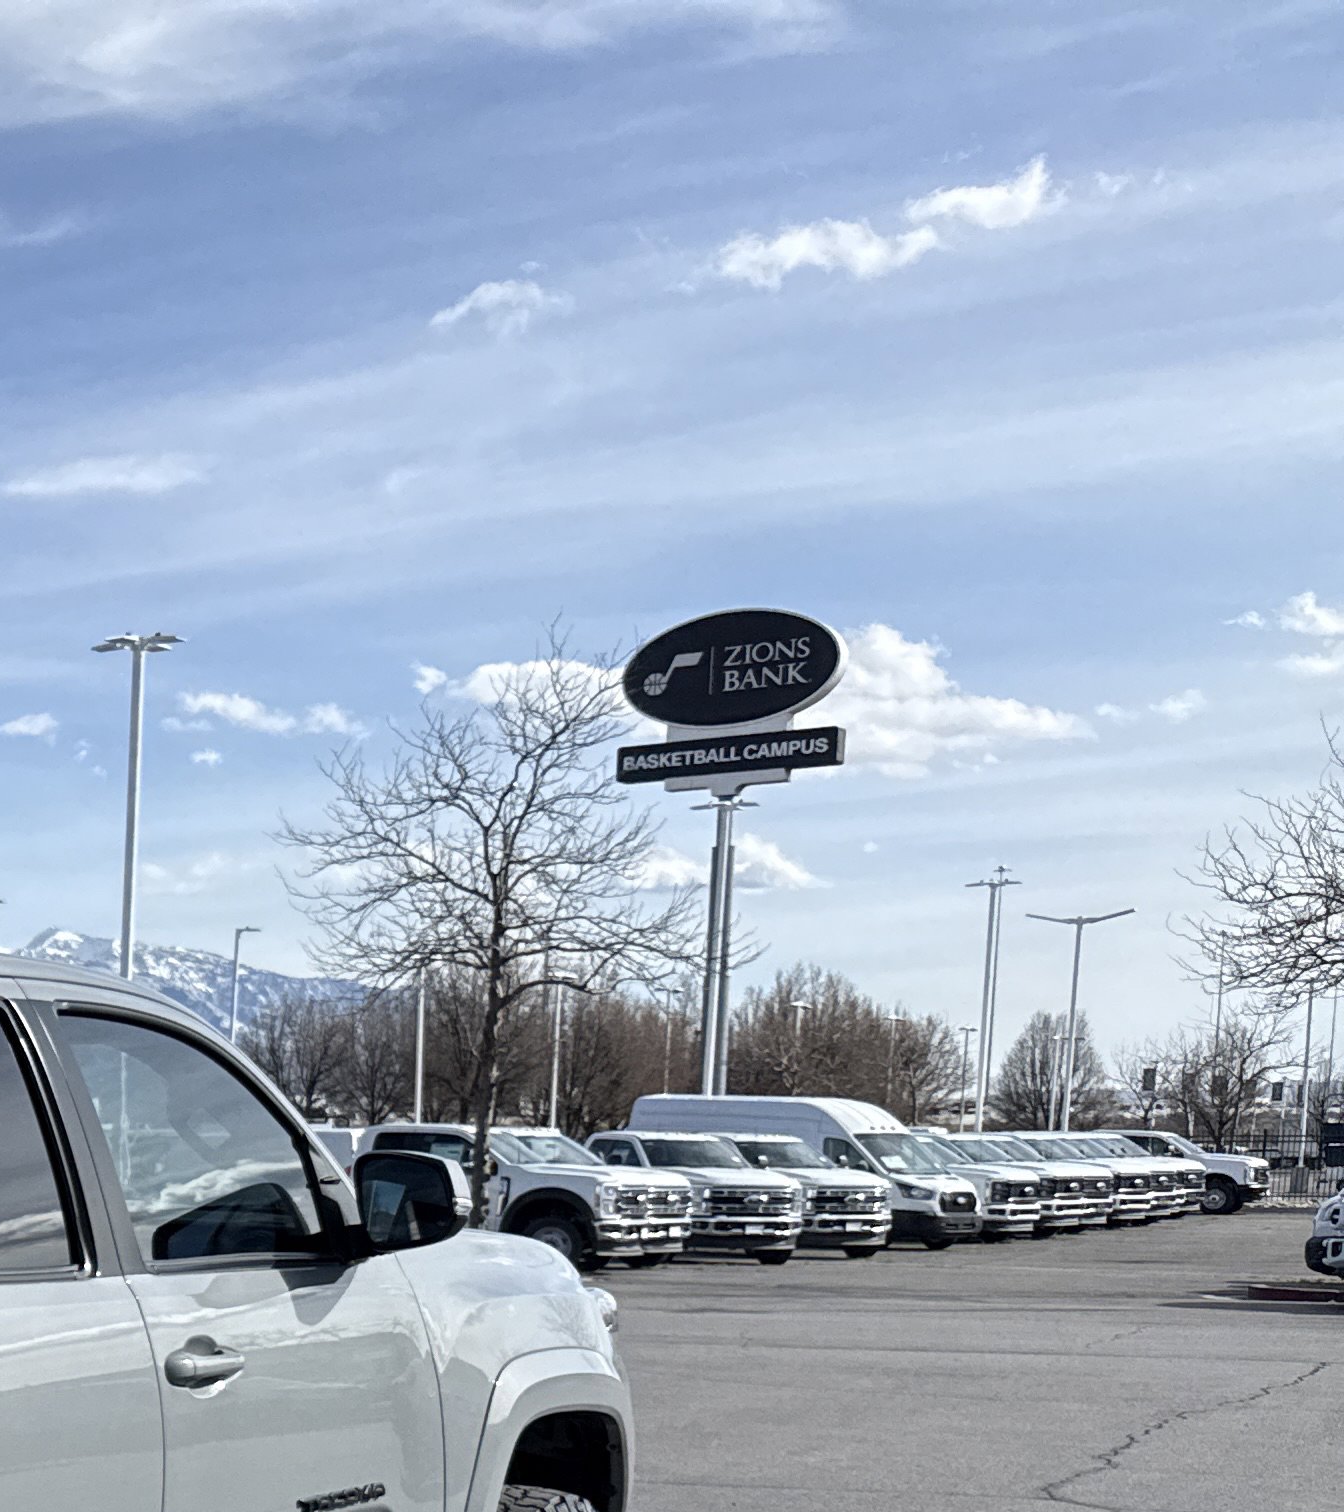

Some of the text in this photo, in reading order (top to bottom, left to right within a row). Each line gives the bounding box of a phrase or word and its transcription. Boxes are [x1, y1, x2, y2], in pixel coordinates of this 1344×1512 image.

[722, 637, 811, 667] ZIONS
[722, 661, 808, 693] BANK
[622, 737, 830, 771] BASKETBALL CAMPUS
